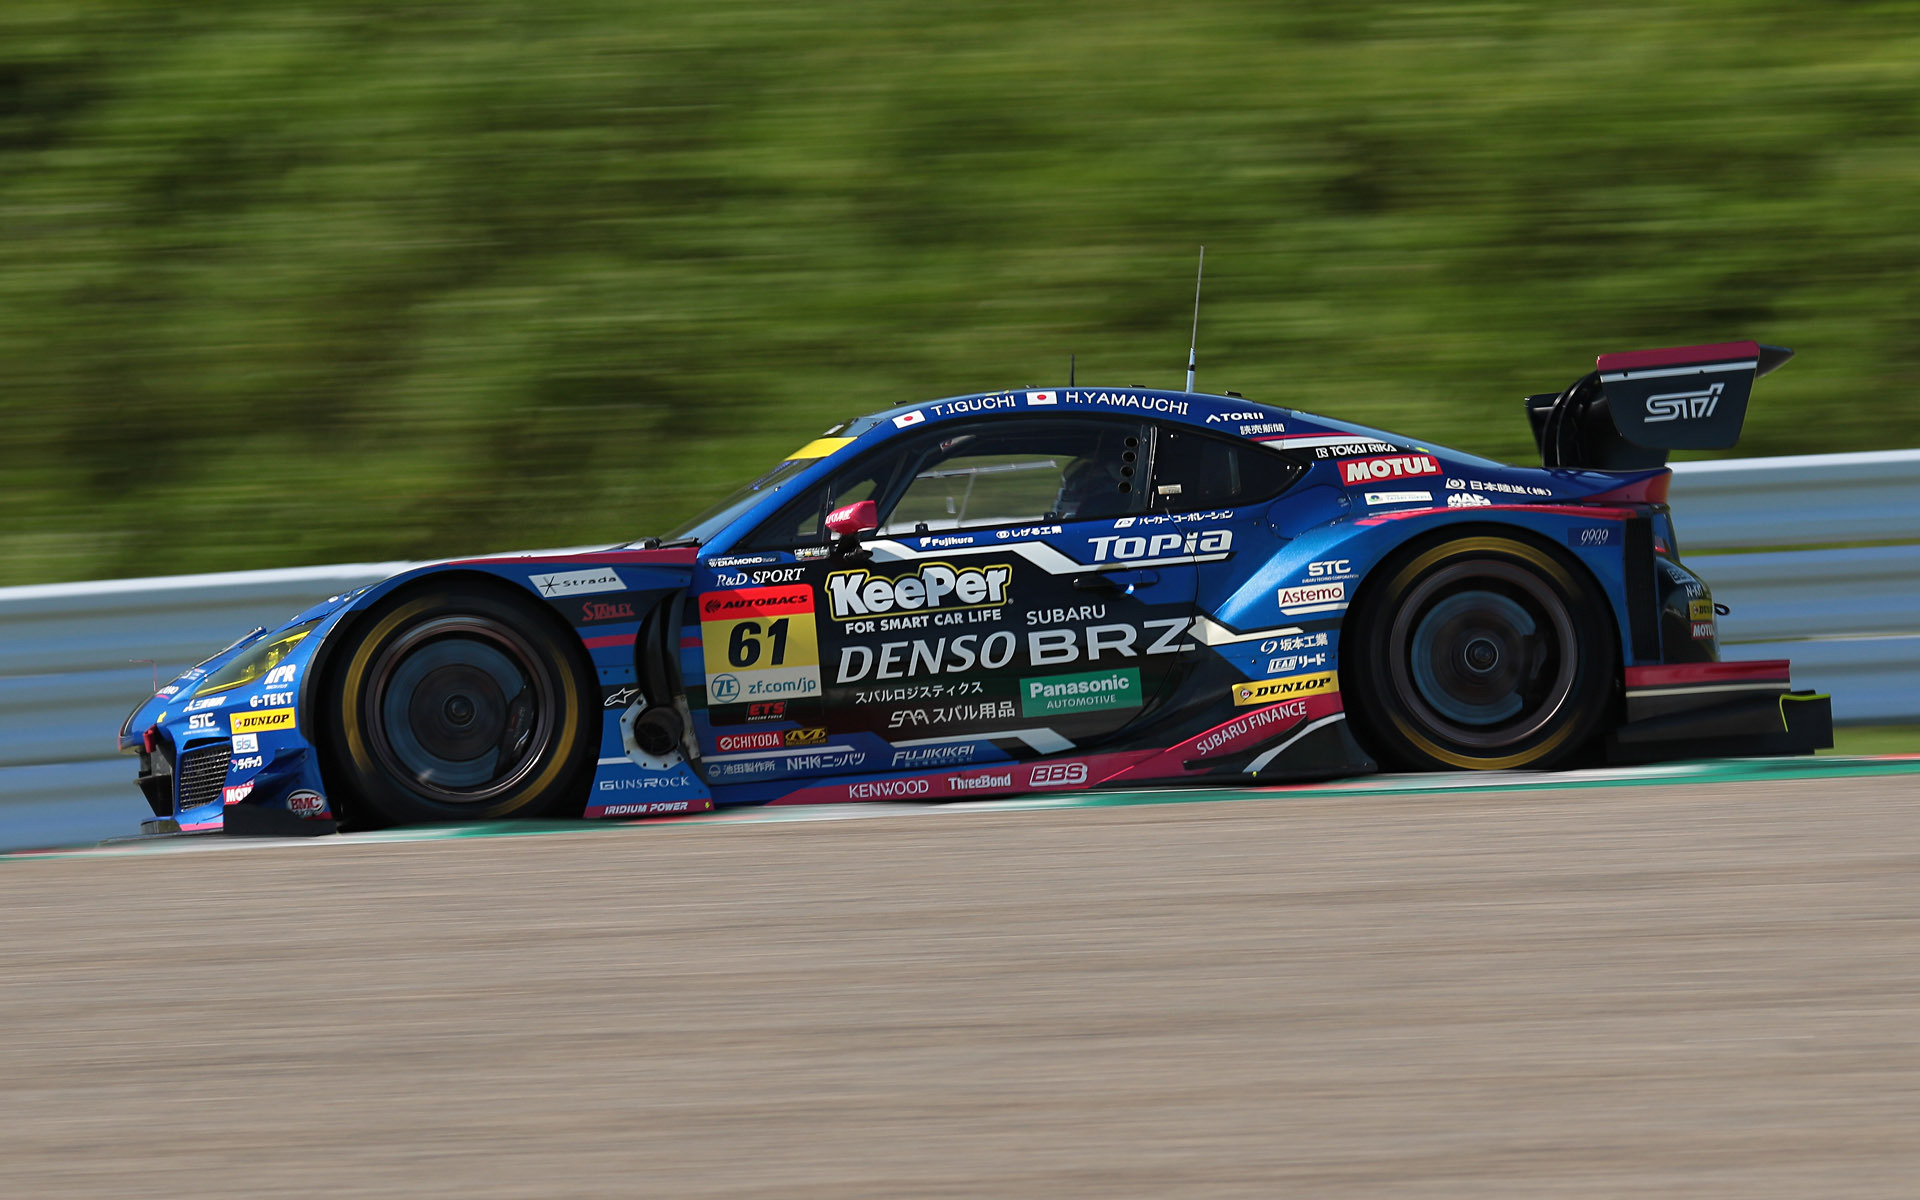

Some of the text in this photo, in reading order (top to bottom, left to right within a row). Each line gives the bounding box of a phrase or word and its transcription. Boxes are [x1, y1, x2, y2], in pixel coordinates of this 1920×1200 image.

[931, 395, 1016, 417] T.IGUCHI
[1065, 391, 1189, 416] H.YAMAUCHI
[1220, 412, 1264, 422] TORII
[1330, 443, 1398, 457] TOKAI RIKA
[1347, 456, 1437, 483] MOTUL
[931, 536, 974, 548] Fujikura
[717, 556, 763, 568] DIAMOND
[1308, 559, 1351, 577] STC
[562, 576, 617, 588] Strada
[715, 567, 806, 588] R&D SPORT
[722, 594, 808, 610] AUTOBACS
[1281, 587, 1343, 606] Astemo
[845, 608, 1002, 635] FOR SMART CAR LIFE
[1026, 604, 1106, 625] SUBARU
[728, 617, 790, 668] 61
[1027, 616, 1196, 667] BRZ
[836, 631, 1016, 684] DENSO
[1298, 653, 1326, 668] リード
[748, 677, 817, 695] zf.com/jp
[855, 680, 984, 705] スバルロジスティクス
[1029, 674, 1130, 699] Panasonic
[1255, 677, 1331, 698] DUNLOP
[249, 691, 294, 708] G-TEKT
[749, 701, 786, 716] ETS
[1046, 694, 1117, 710] AUTOMOTIVE
[189, 712, 216, 729] STC
[243, 713, 290, 728] DUNLOP
[932, 700, 1016, 725] スバル用品
[1196, 701, 1308, 756] SUBARU FINANCE
[732, 733, 780, 750] CHIYODA
[891, 744, 976, 767] FUJIKIKAI
[948, 773, 1012, 791] ThreeBond
[1028, 762, 1089, 788] BBS
[849, 779, 929, 799] KENWOOD
[604, 801, 689, 815] IRIDIUM POWER
